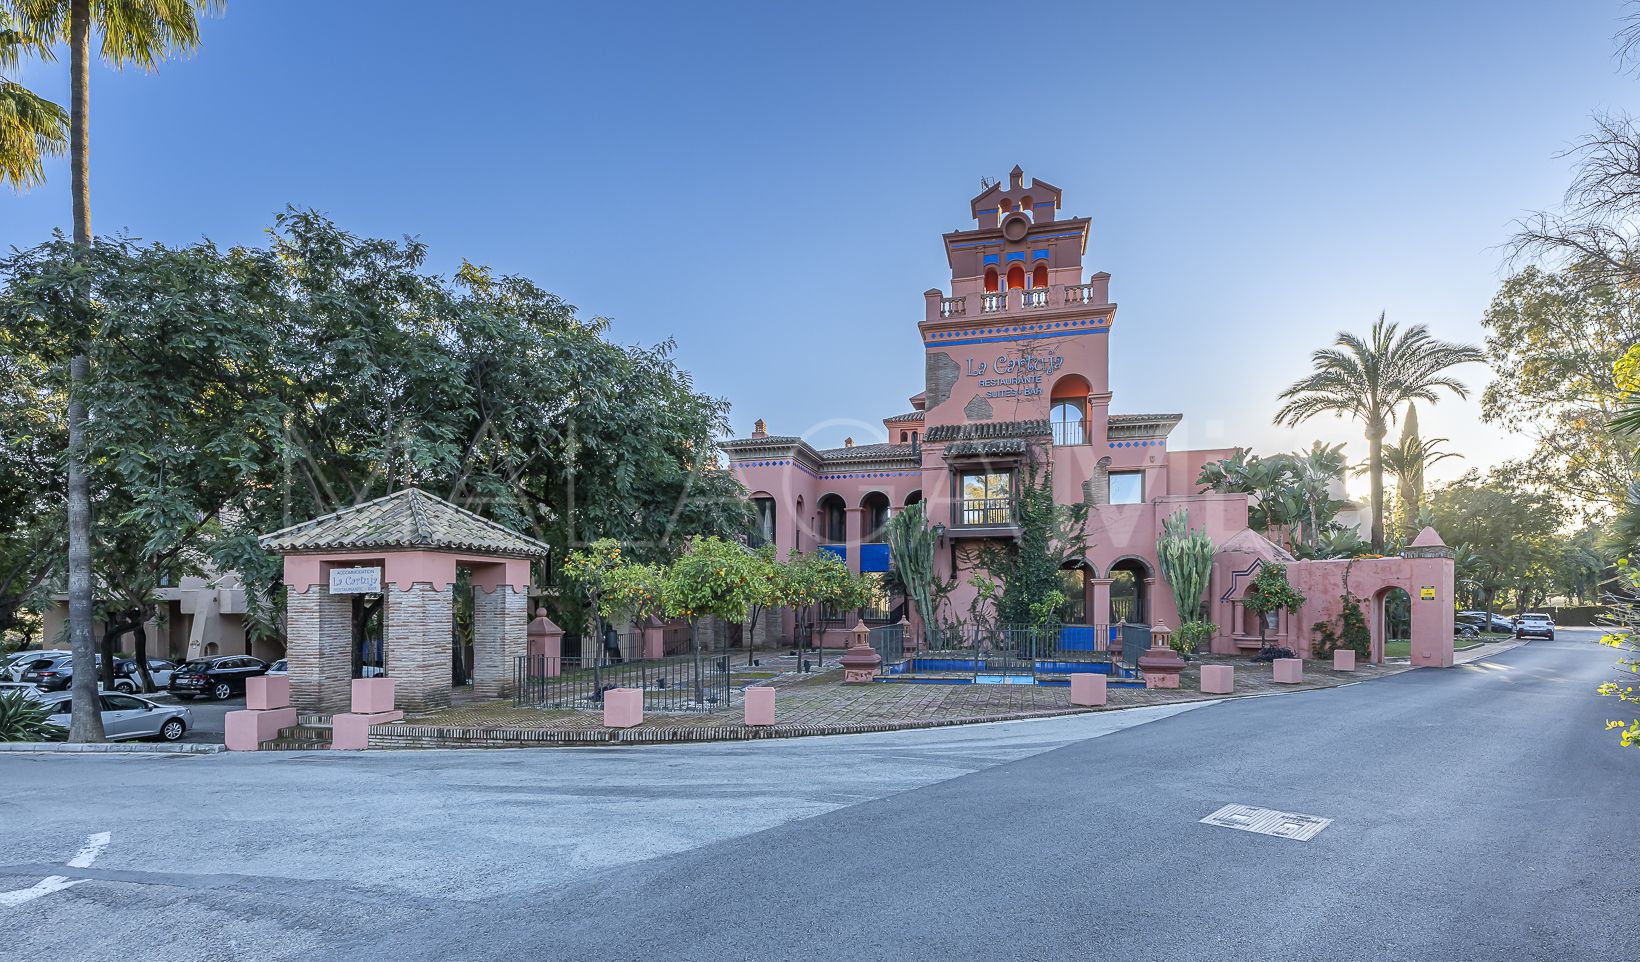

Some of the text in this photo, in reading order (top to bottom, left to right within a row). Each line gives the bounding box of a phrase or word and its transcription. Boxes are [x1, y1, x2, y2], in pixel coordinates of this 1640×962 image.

[967, 350, 1063, 376] La Cartuja
[978, 375, 1042, 387] RESTAURANTE
[986, 387, 1043, 398] SUITES BAR
[333, 576, 342, 587] La
